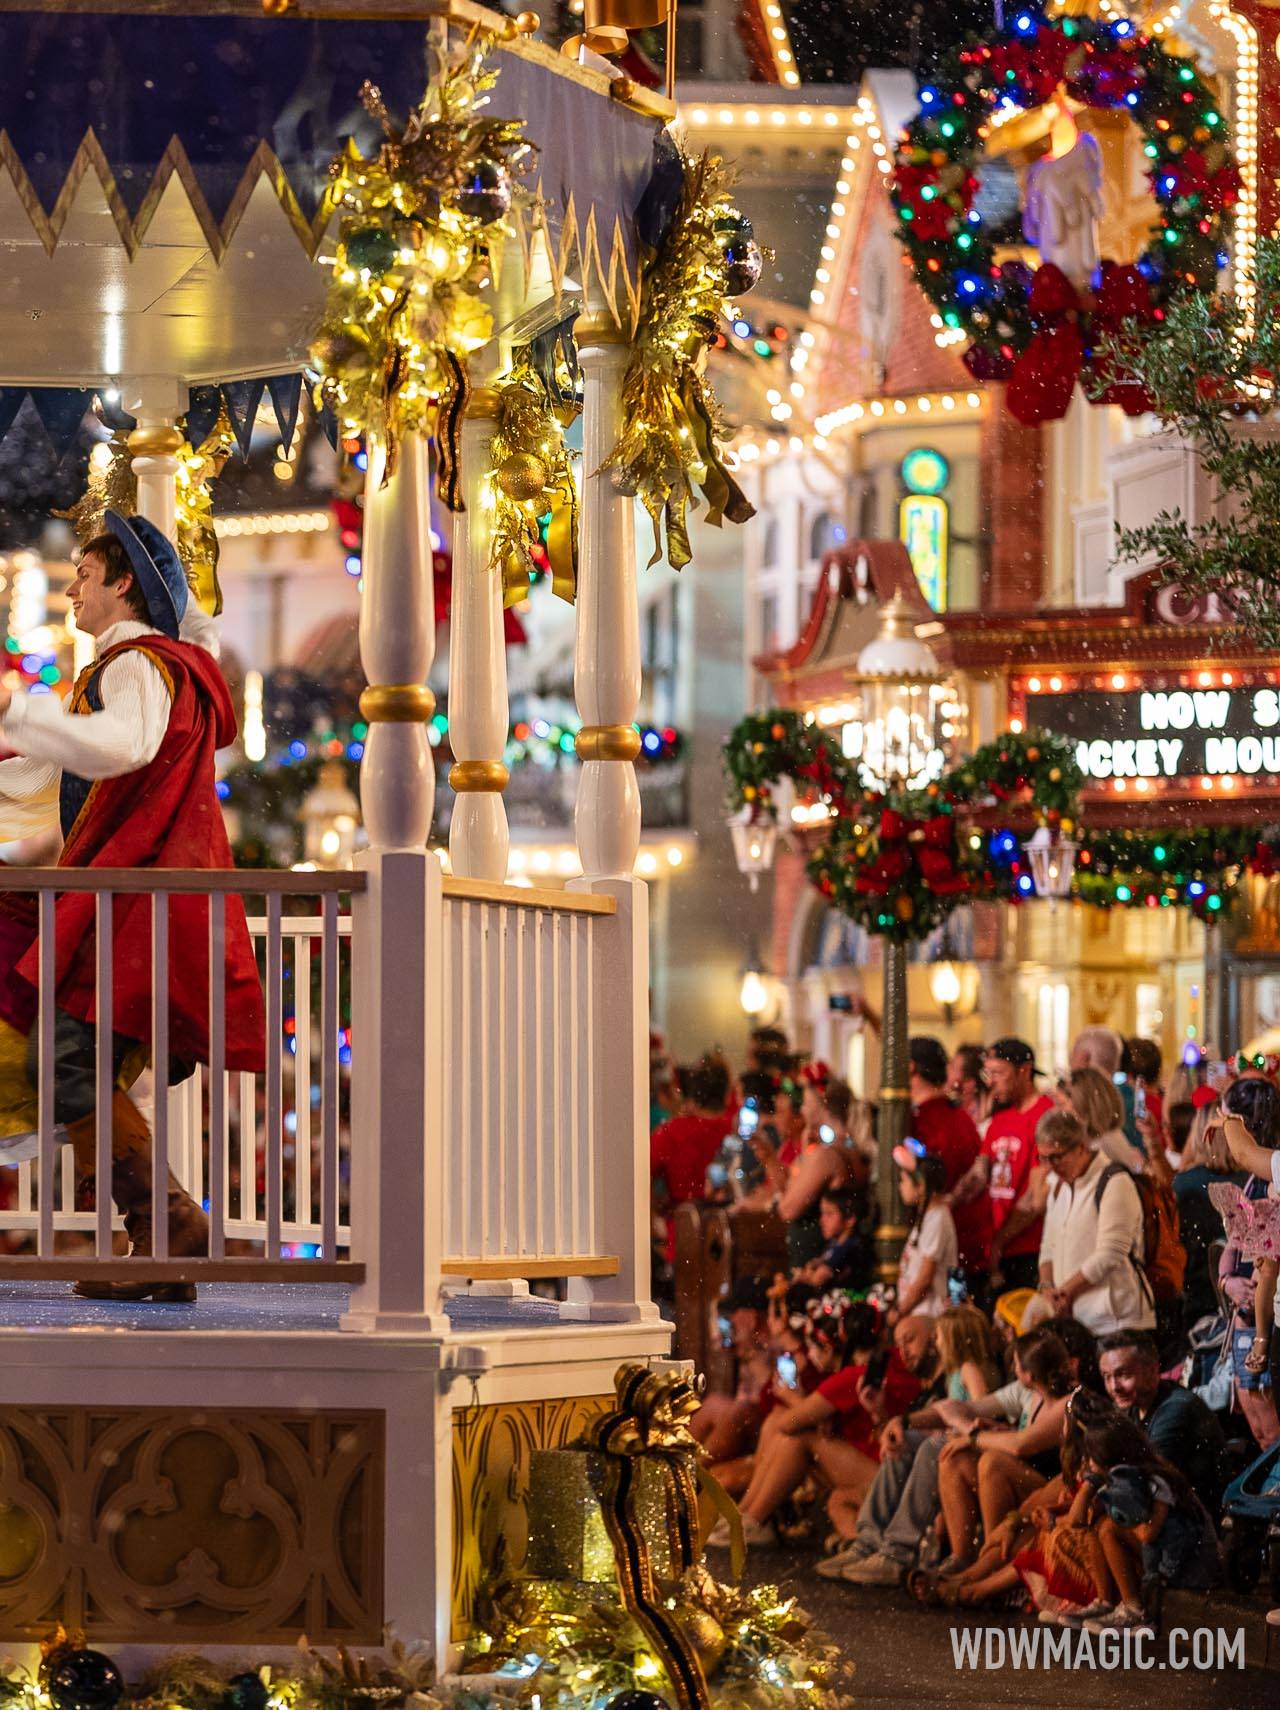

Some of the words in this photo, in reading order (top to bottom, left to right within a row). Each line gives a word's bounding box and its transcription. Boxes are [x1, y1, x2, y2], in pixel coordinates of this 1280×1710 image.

[1140, 690, 1231, 730] NOW
[1253, 689, 1280, 727] S
[1075, 738, 1183, 778] ICKEY
